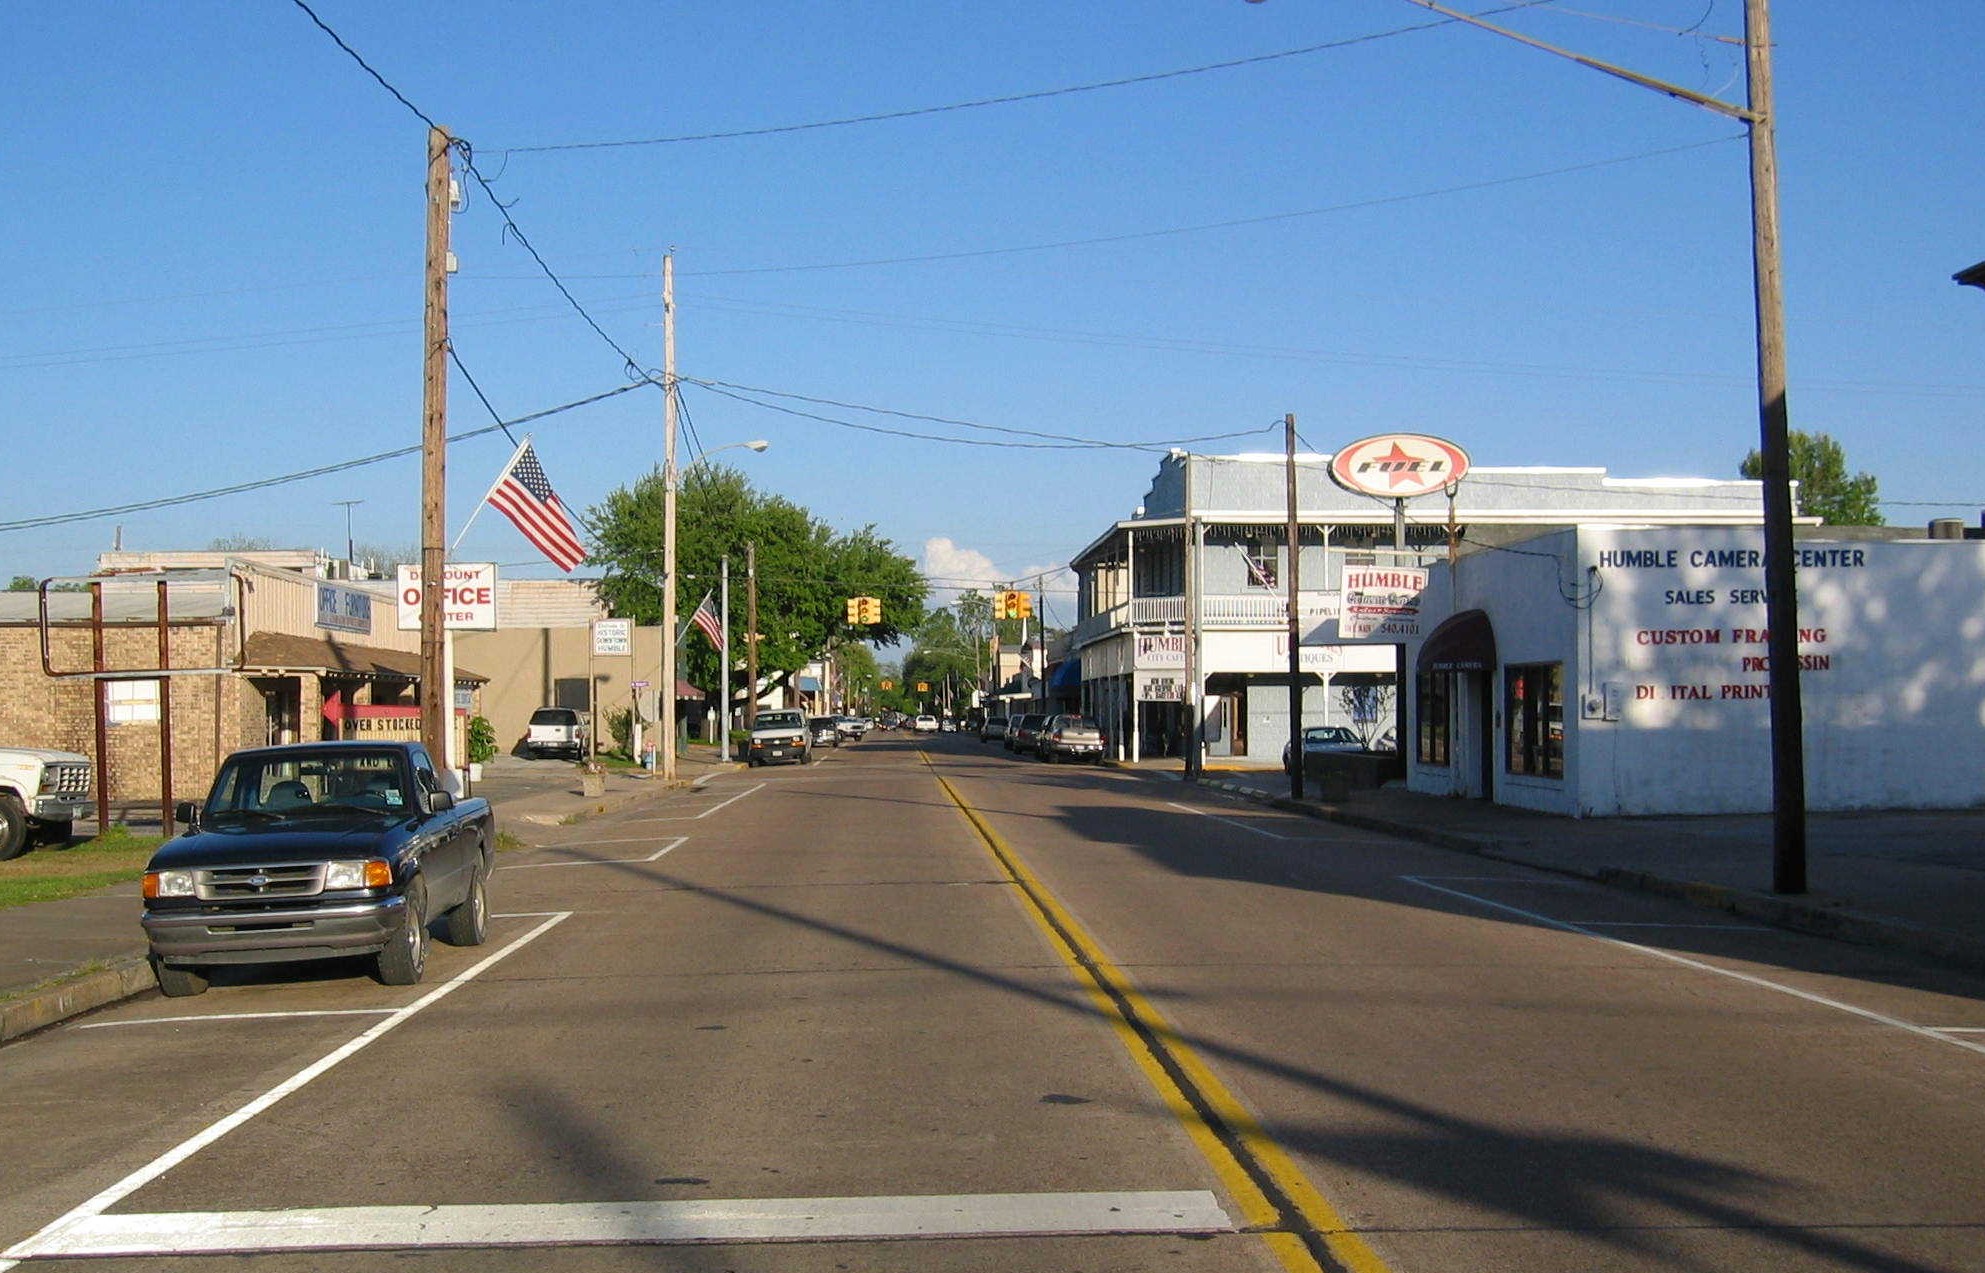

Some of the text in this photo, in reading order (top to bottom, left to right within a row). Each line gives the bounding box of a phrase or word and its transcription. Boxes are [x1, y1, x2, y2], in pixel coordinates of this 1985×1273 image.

[1356, 460, 1446, 473] FUEL
[1600, 550, 1678, 568] HUMBLE
[409, 570, 481, 581] DOUNT
[1347, 571, 1424, 591] HUMBLE
[402, 587, 491, 606] OFICE
[1665, 588, 1715, 605] SALES
[418, 611, 474, 622] TER
[1309, 606, 1341, 617] PIPELI
[1636, 628, 1827, 646] CUSTOM FRANG
[1138, 636, 1185, 657] HUMBL
[1742, 655, 1830, 673] PROSSIN
[344, 718, 421, 731] OVER STOCKED
